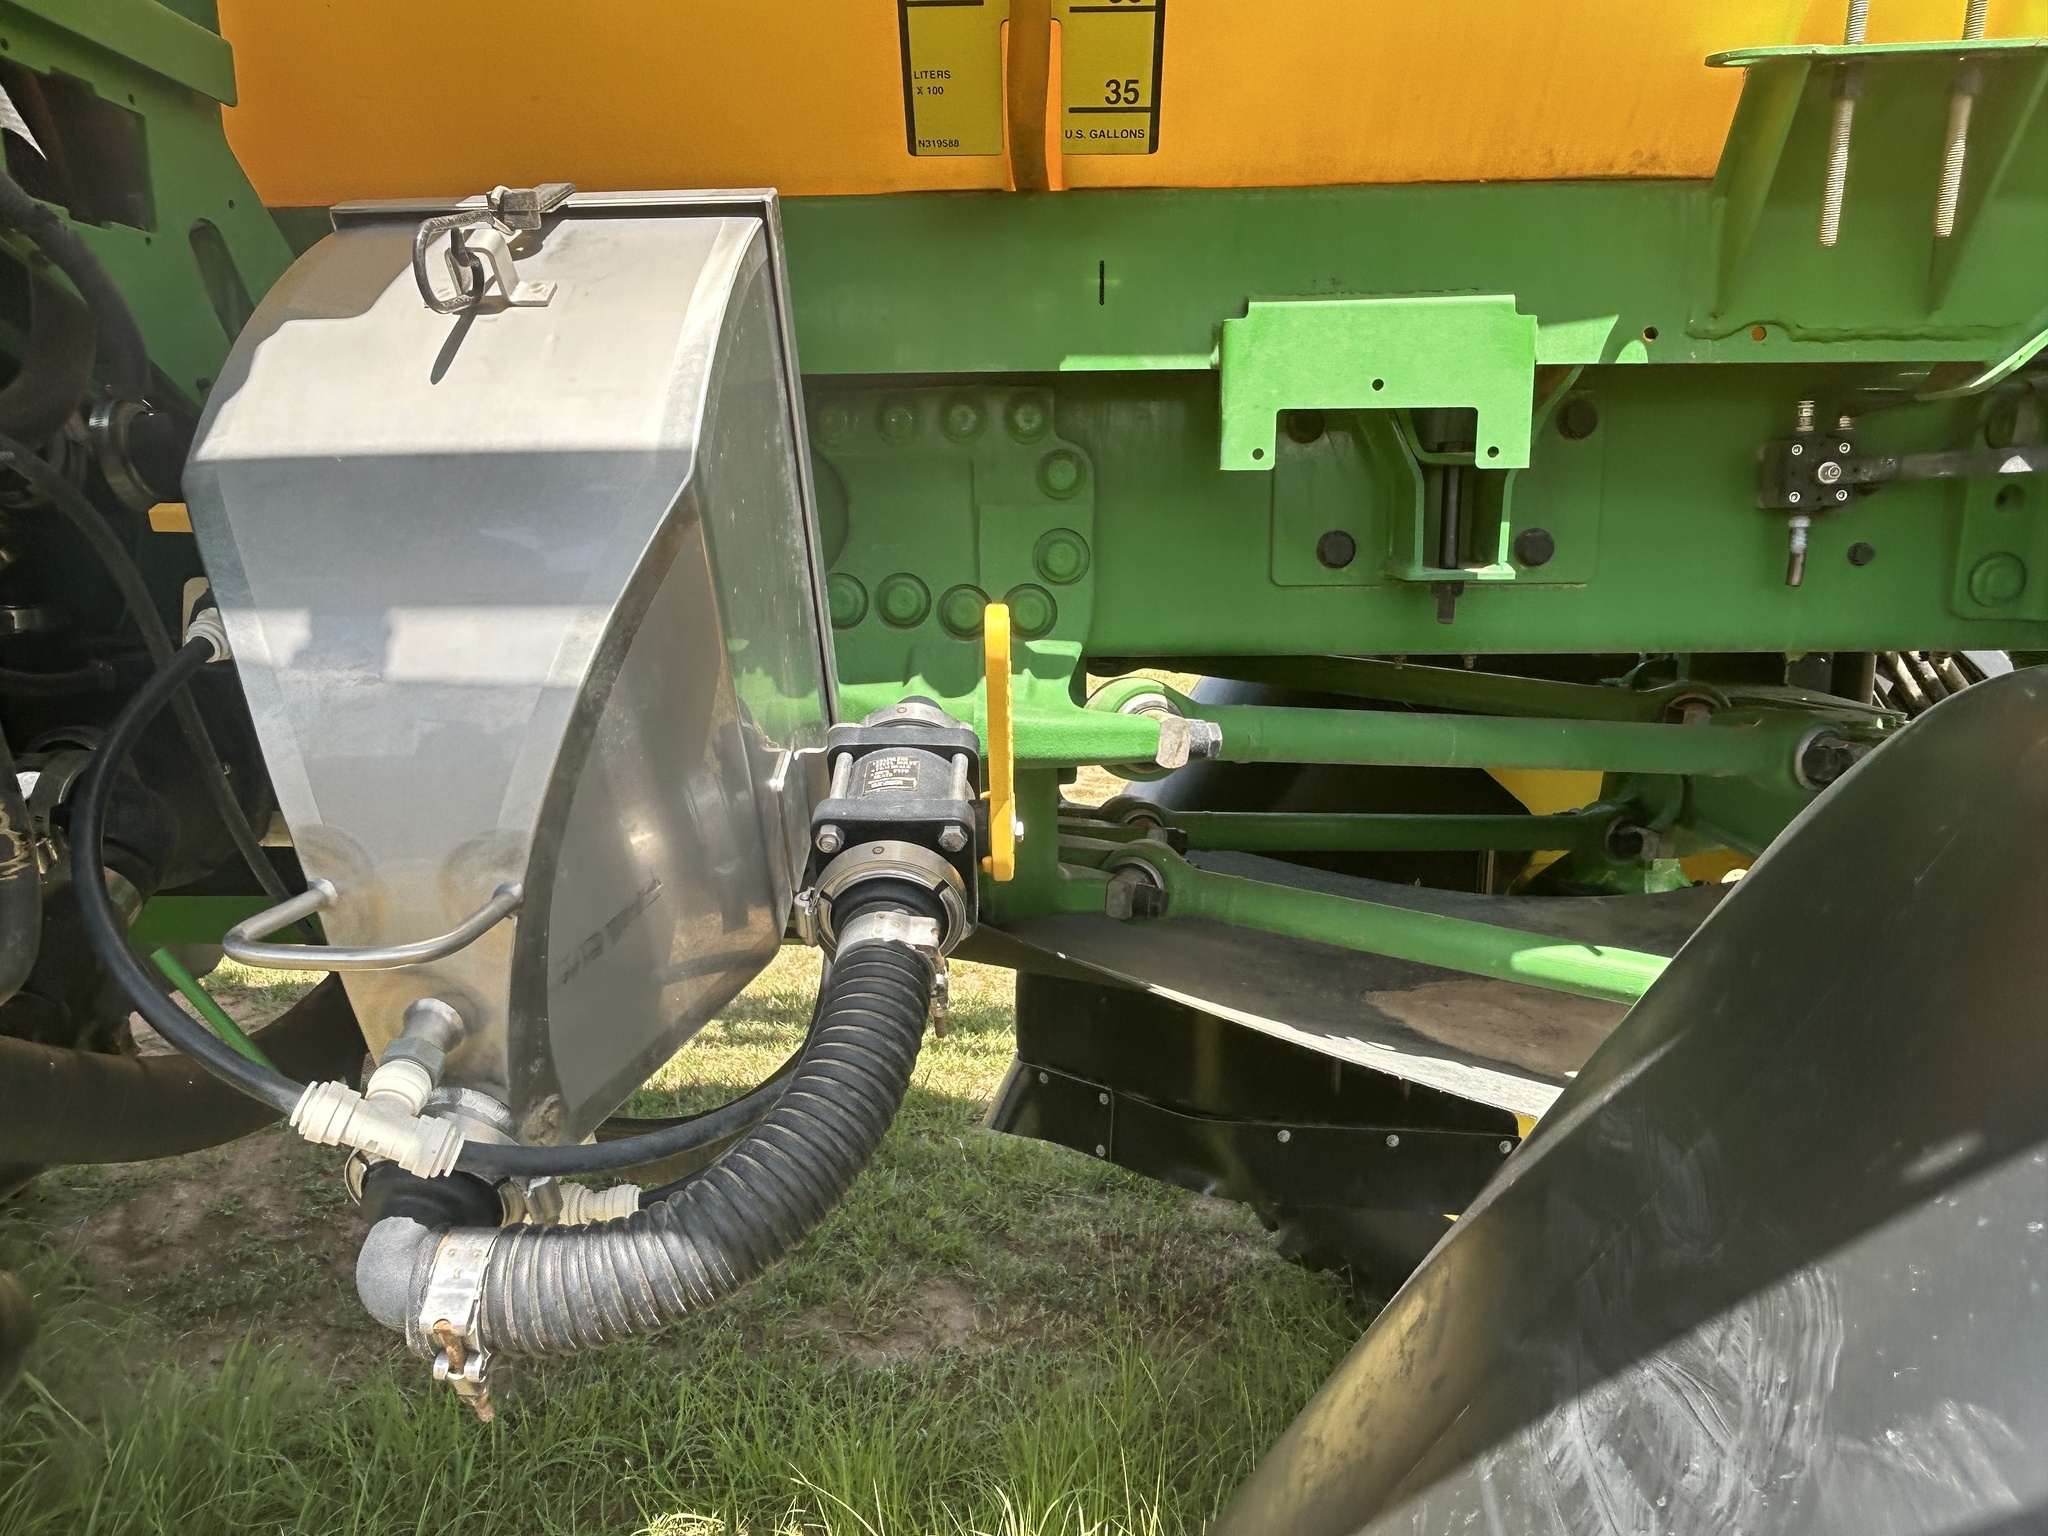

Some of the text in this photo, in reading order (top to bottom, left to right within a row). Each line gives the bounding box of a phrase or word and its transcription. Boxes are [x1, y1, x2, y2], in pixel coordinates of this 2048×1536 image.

[913, 70, 951, 79] LITERS
[916, 86, 944, 95] X 100
[1105, 79, 1140, 105] 35
[1065, 129, 1145, 139] U.S. GALLONS
